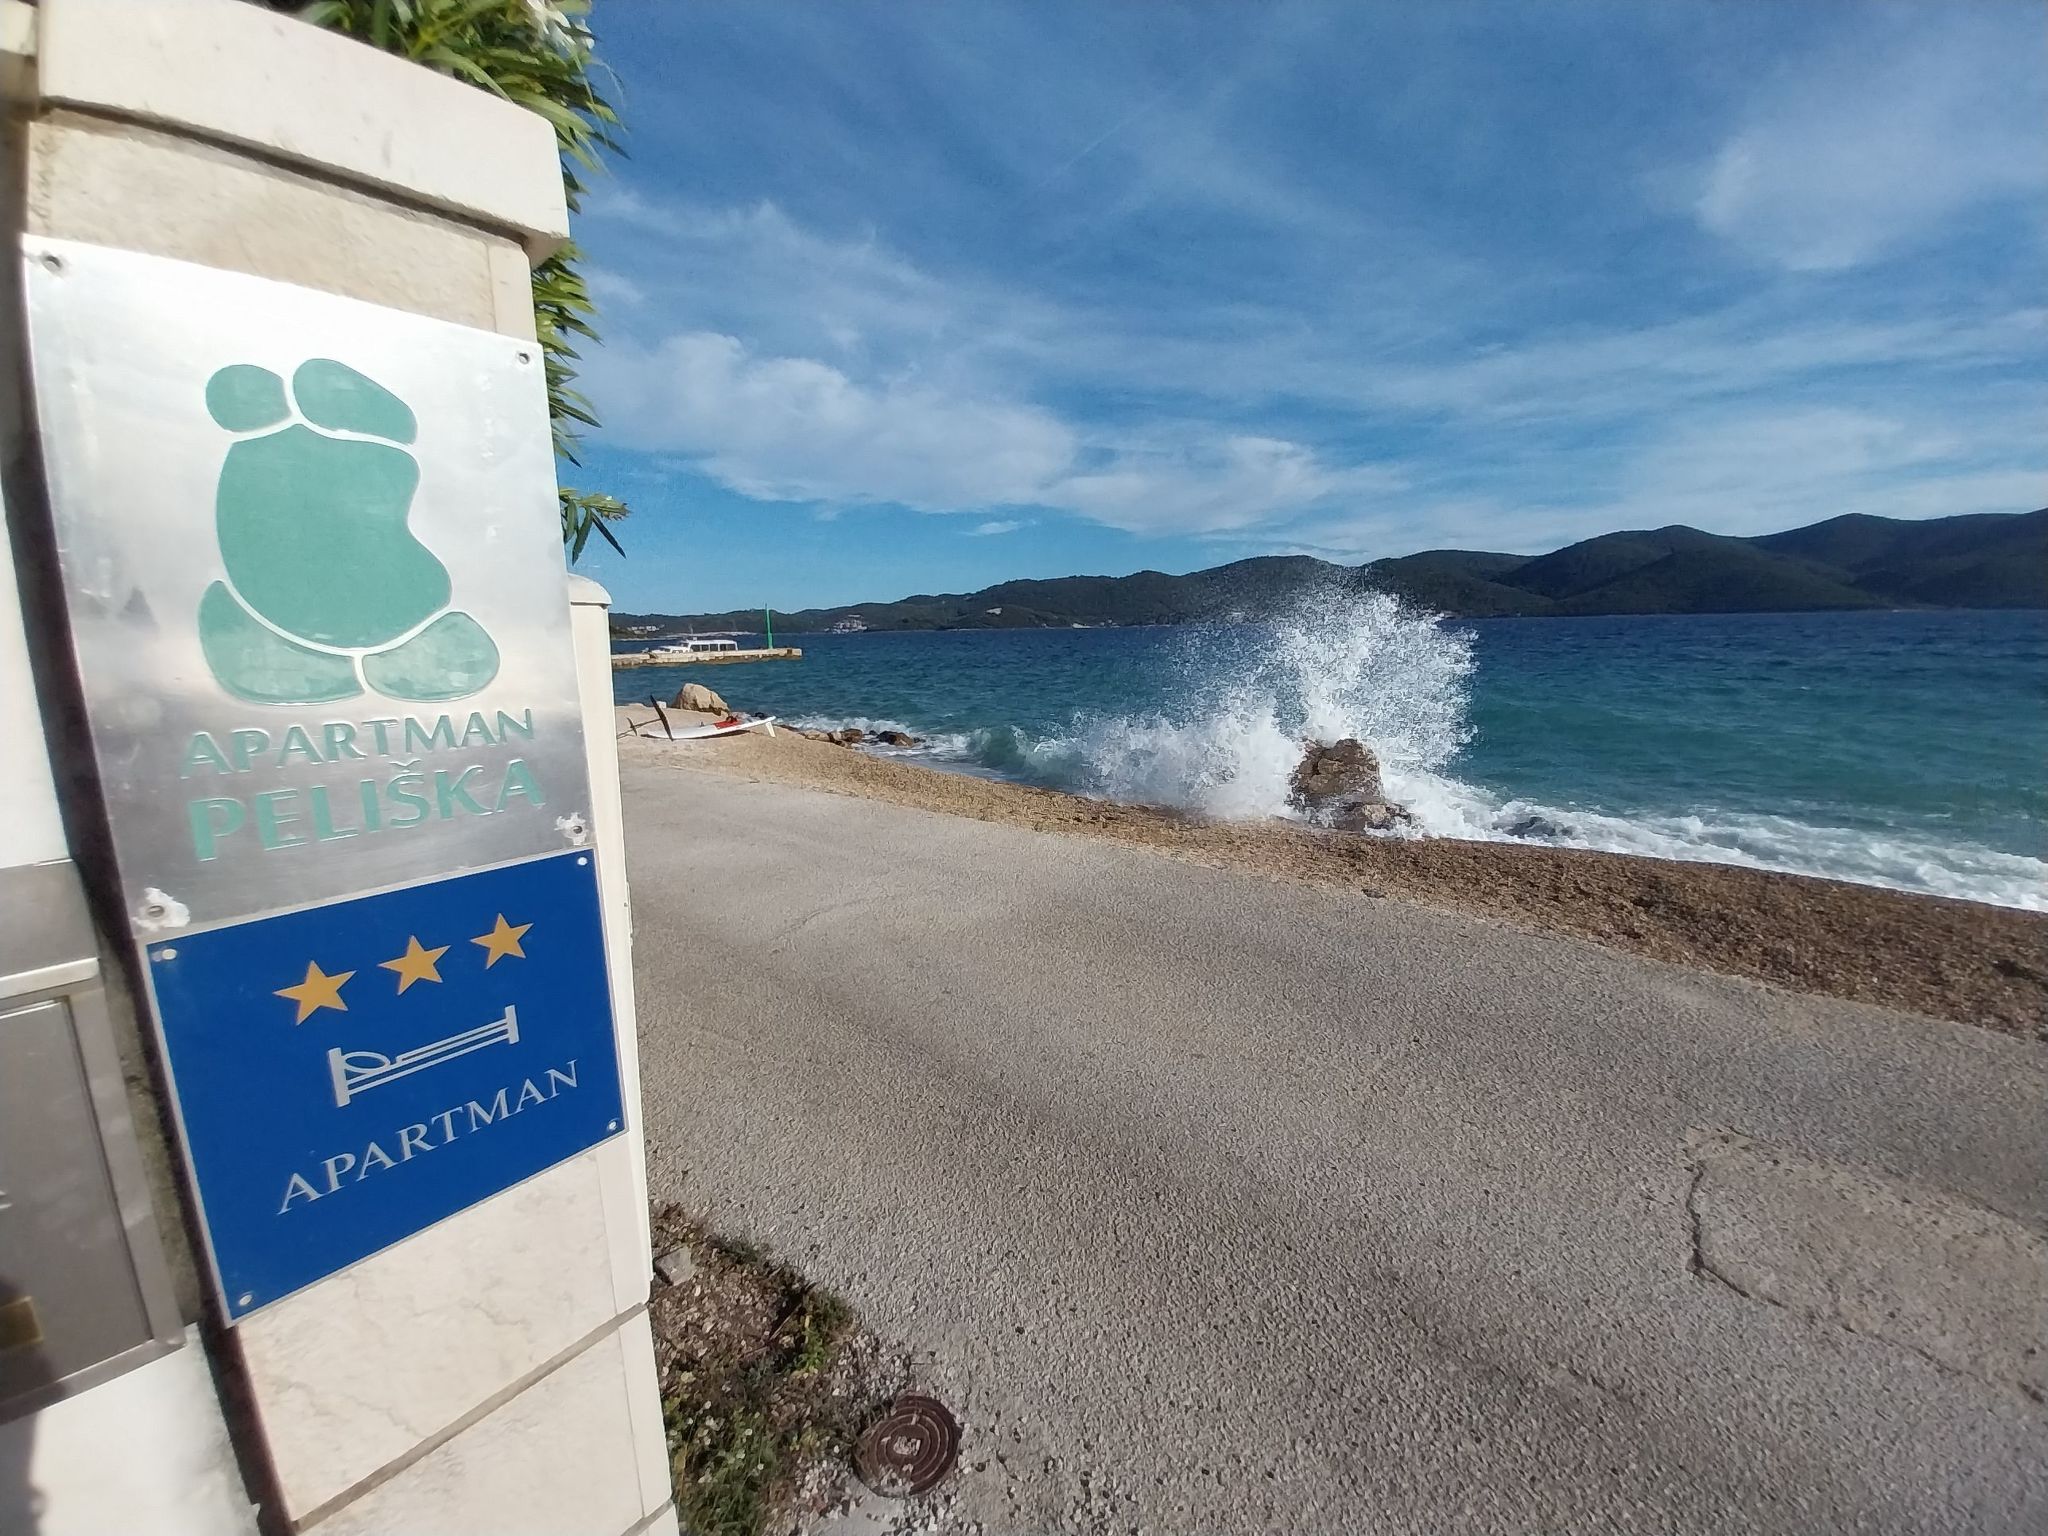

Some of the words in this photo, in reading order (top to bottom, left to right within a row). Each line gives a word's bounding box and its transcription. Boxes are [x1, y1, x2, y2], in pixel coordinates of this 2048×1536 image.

[180, 708, 535, 779] APARTMAN
[188, 758, 546, 862] PELIŠKA
[276, 1059, 579, 1216] APARTMAN
